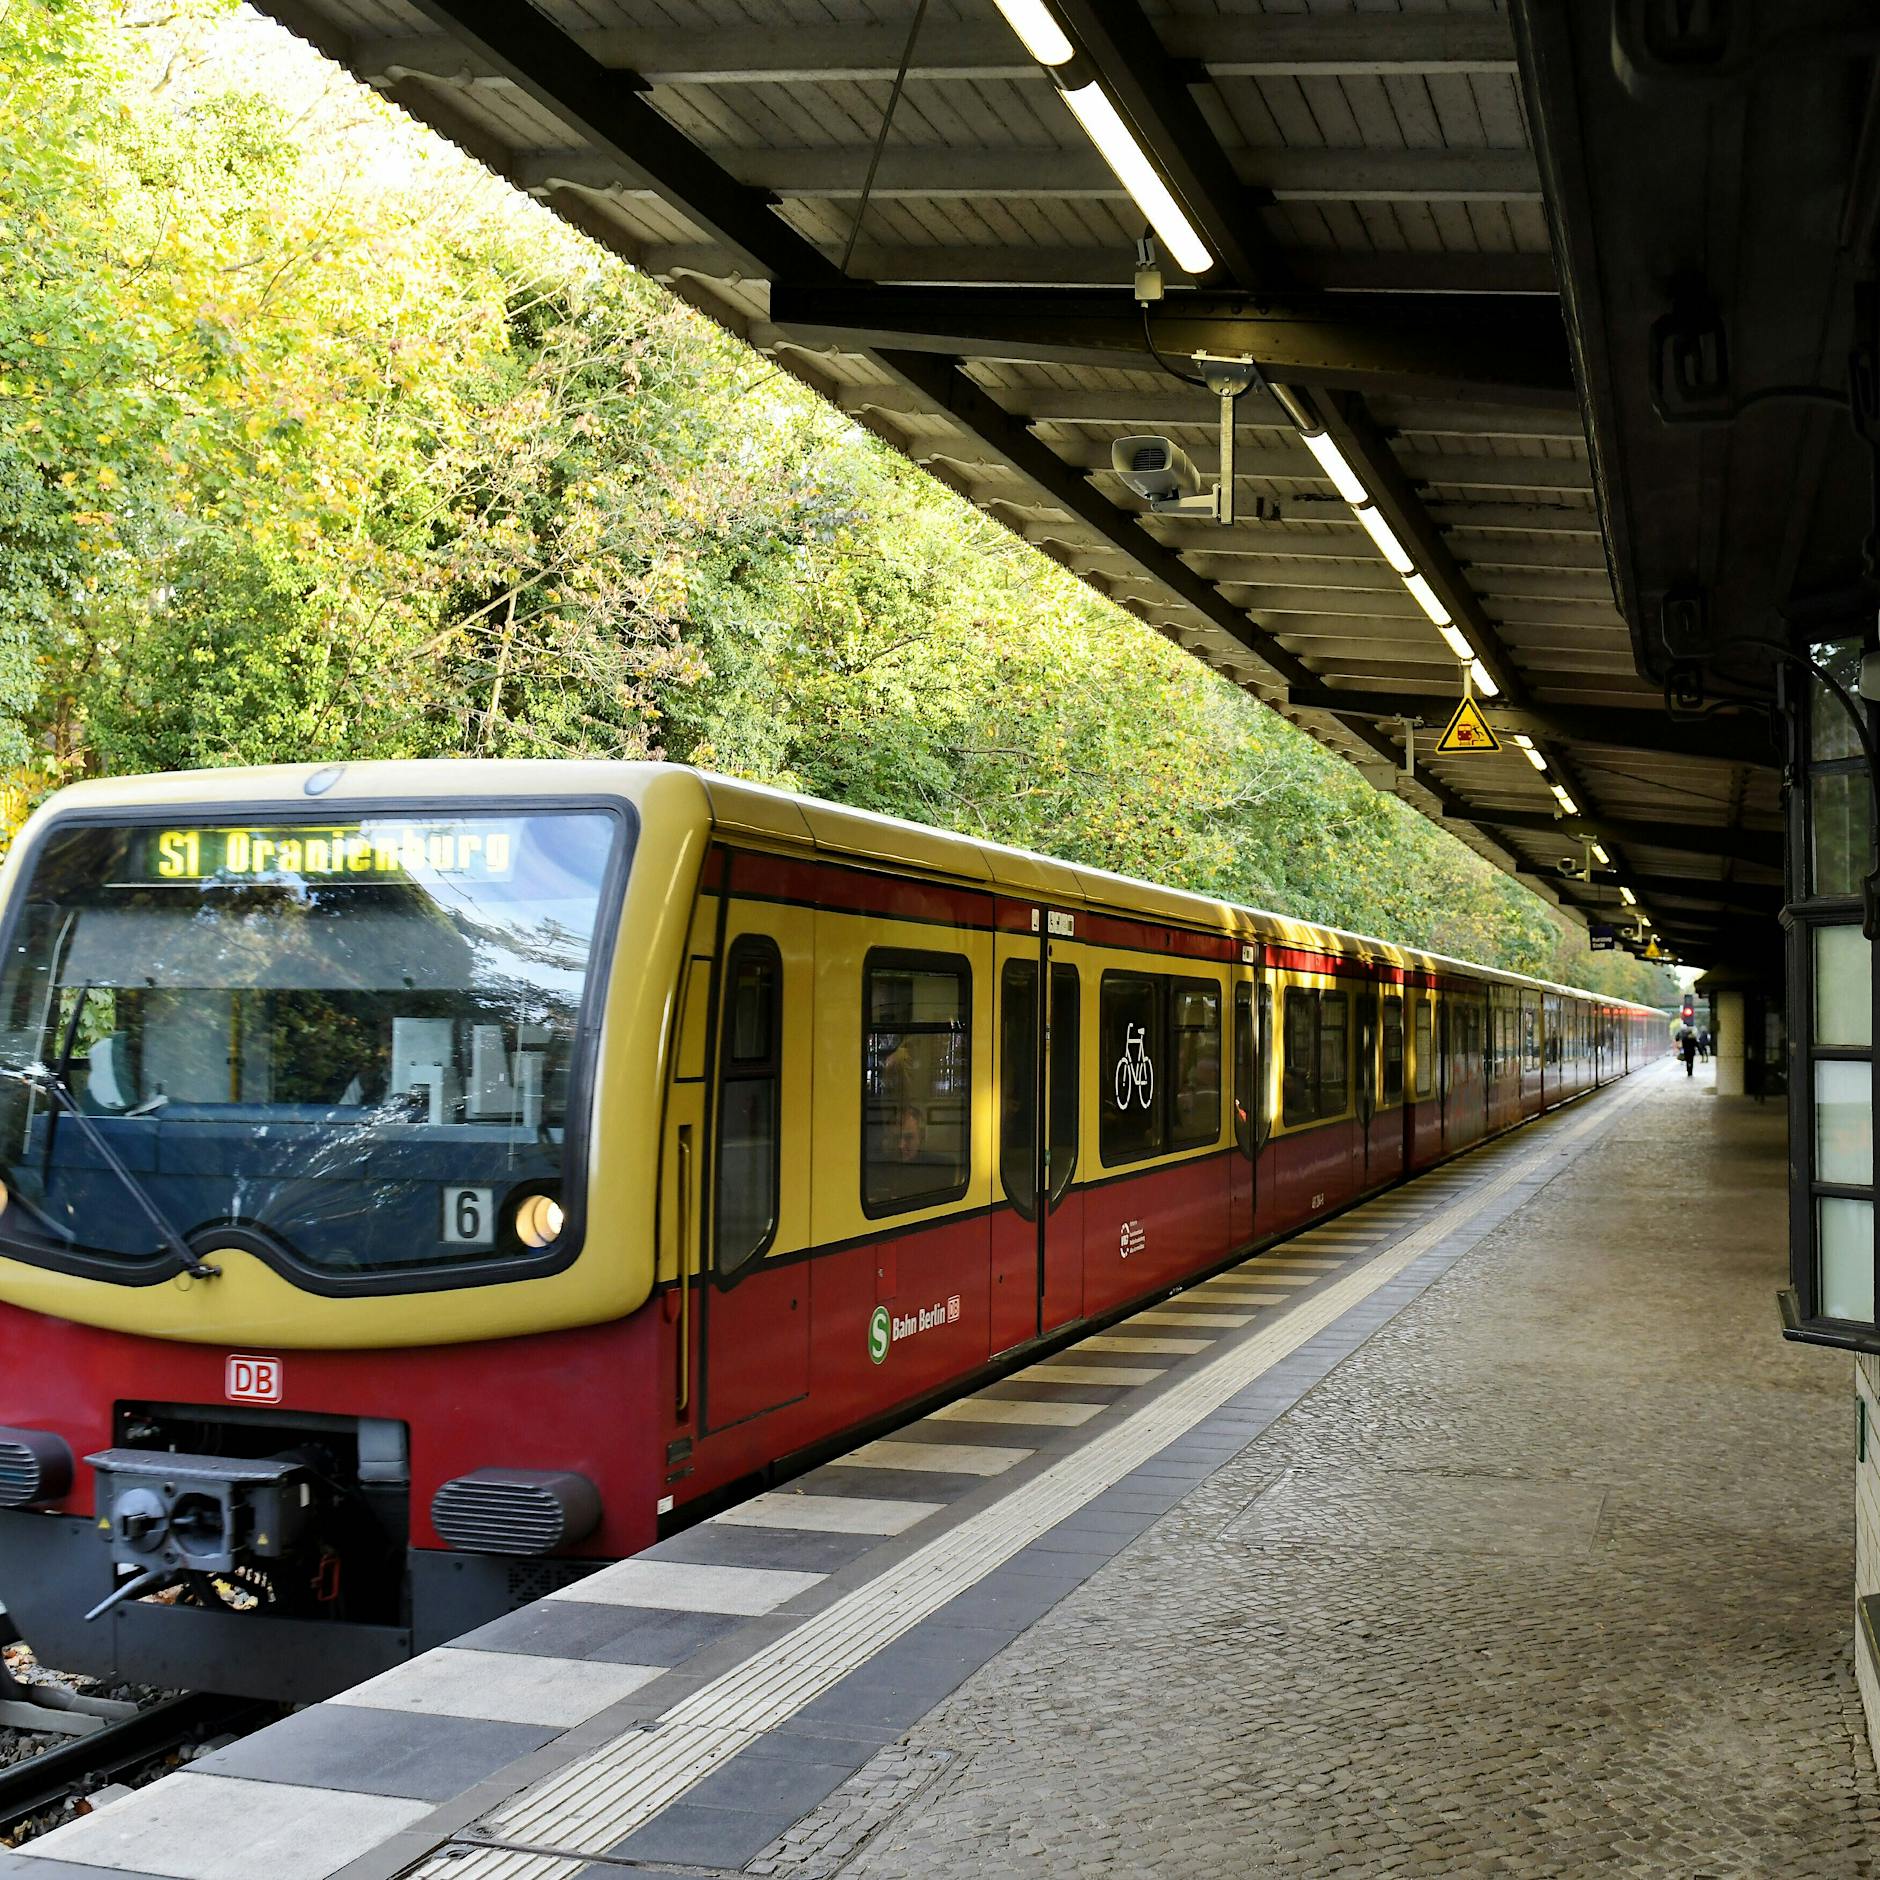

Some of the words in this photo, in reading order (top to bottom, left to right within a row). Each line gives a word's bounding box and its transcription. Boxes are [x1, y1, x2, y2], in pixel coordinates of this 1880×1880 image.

[158, 830, 200, 877] S1
[226, 830, 511, 873] Oranienburg
[457, 1191, 480, 1238] 6
[892, 1313, 917, 1341] Bahn
[919, 1302, 945, 1331] Berlin
[235, 1362, 273, 1394] DB
